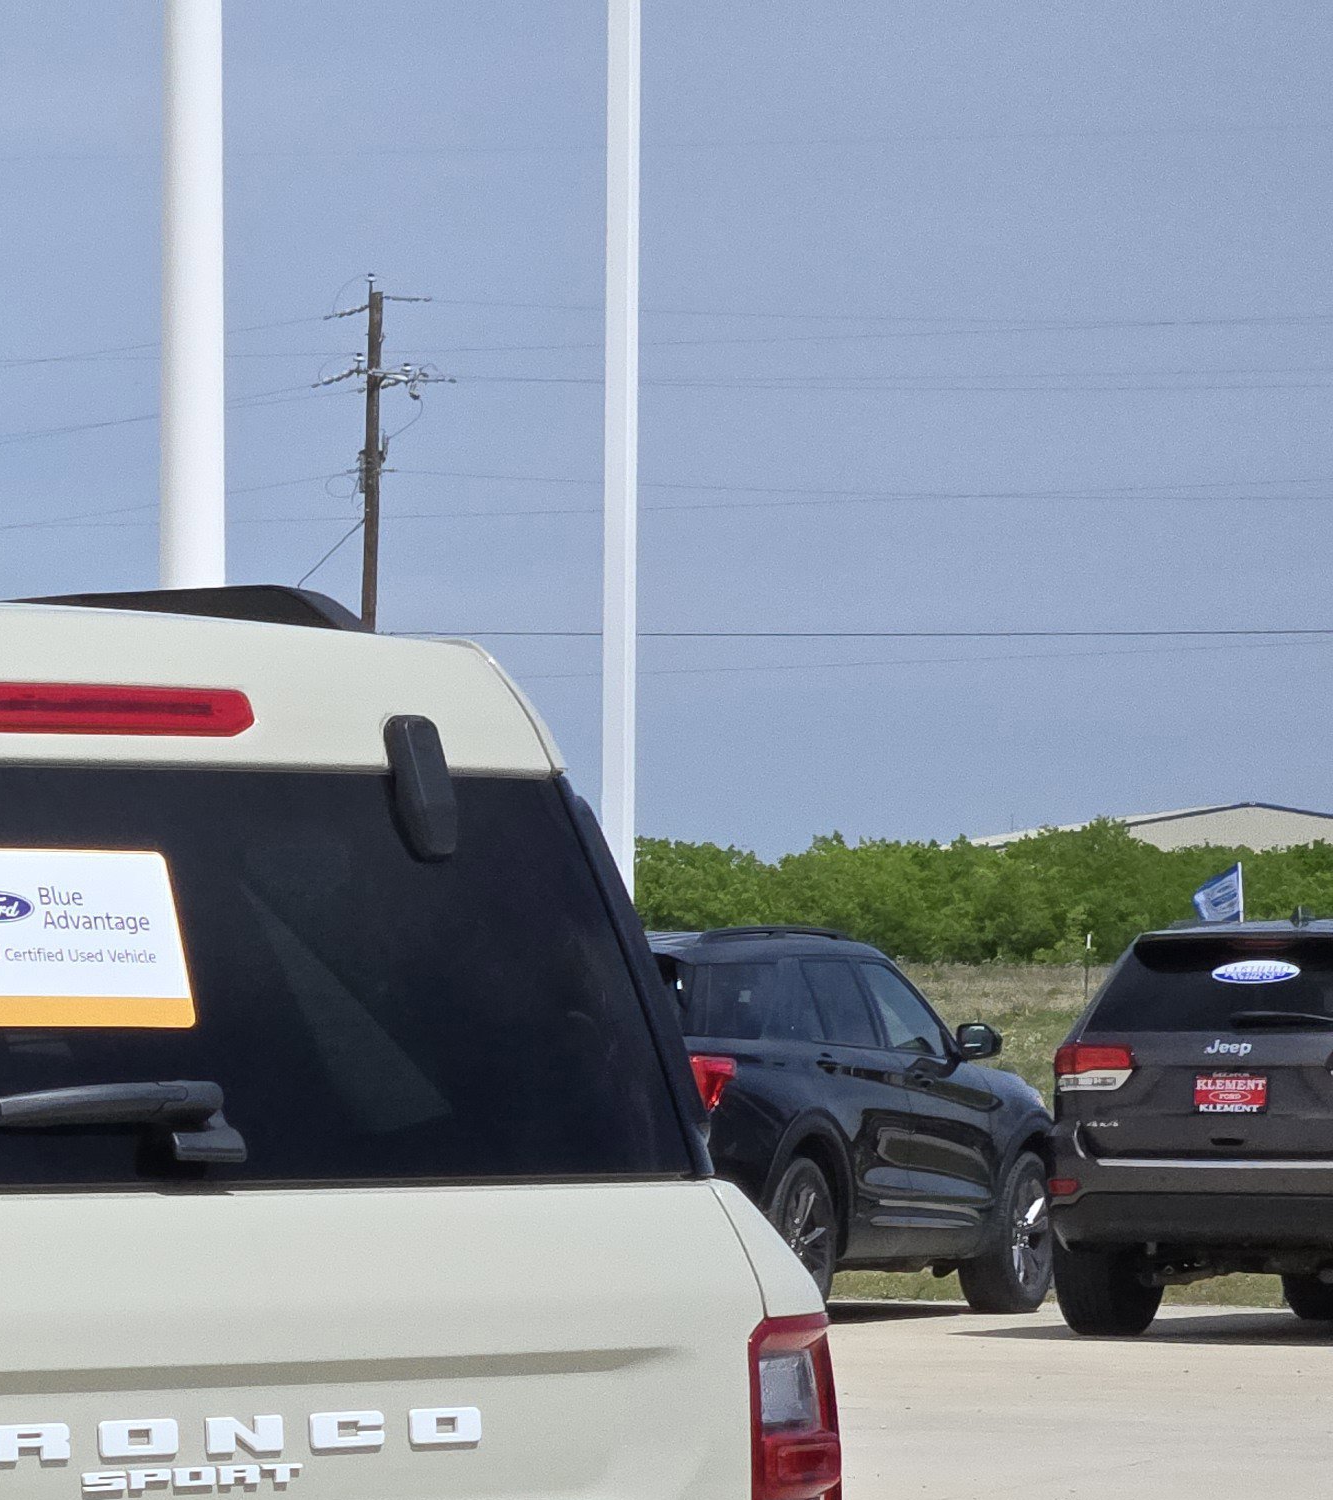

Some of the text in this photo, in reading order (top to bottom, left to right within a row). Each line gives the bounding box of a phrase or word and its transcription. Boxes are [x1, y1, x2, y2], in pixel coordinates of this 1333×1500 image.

[37, 886, 84, 906] Blue
[43, 910, 151, 935] Advantage
[4, 948, 64, 962] Certified
[69, 949, 104, 963] Used
[107, 949, 157, 964] Vehicle
[1204, 1039, 1253, 1057] Jeep
[1196, 1079, 1267, 1091] KLEMENT
[1199, 1103, 1260, 1112] KLEMENT
[81, 1463, 304, 1499] SPORT
